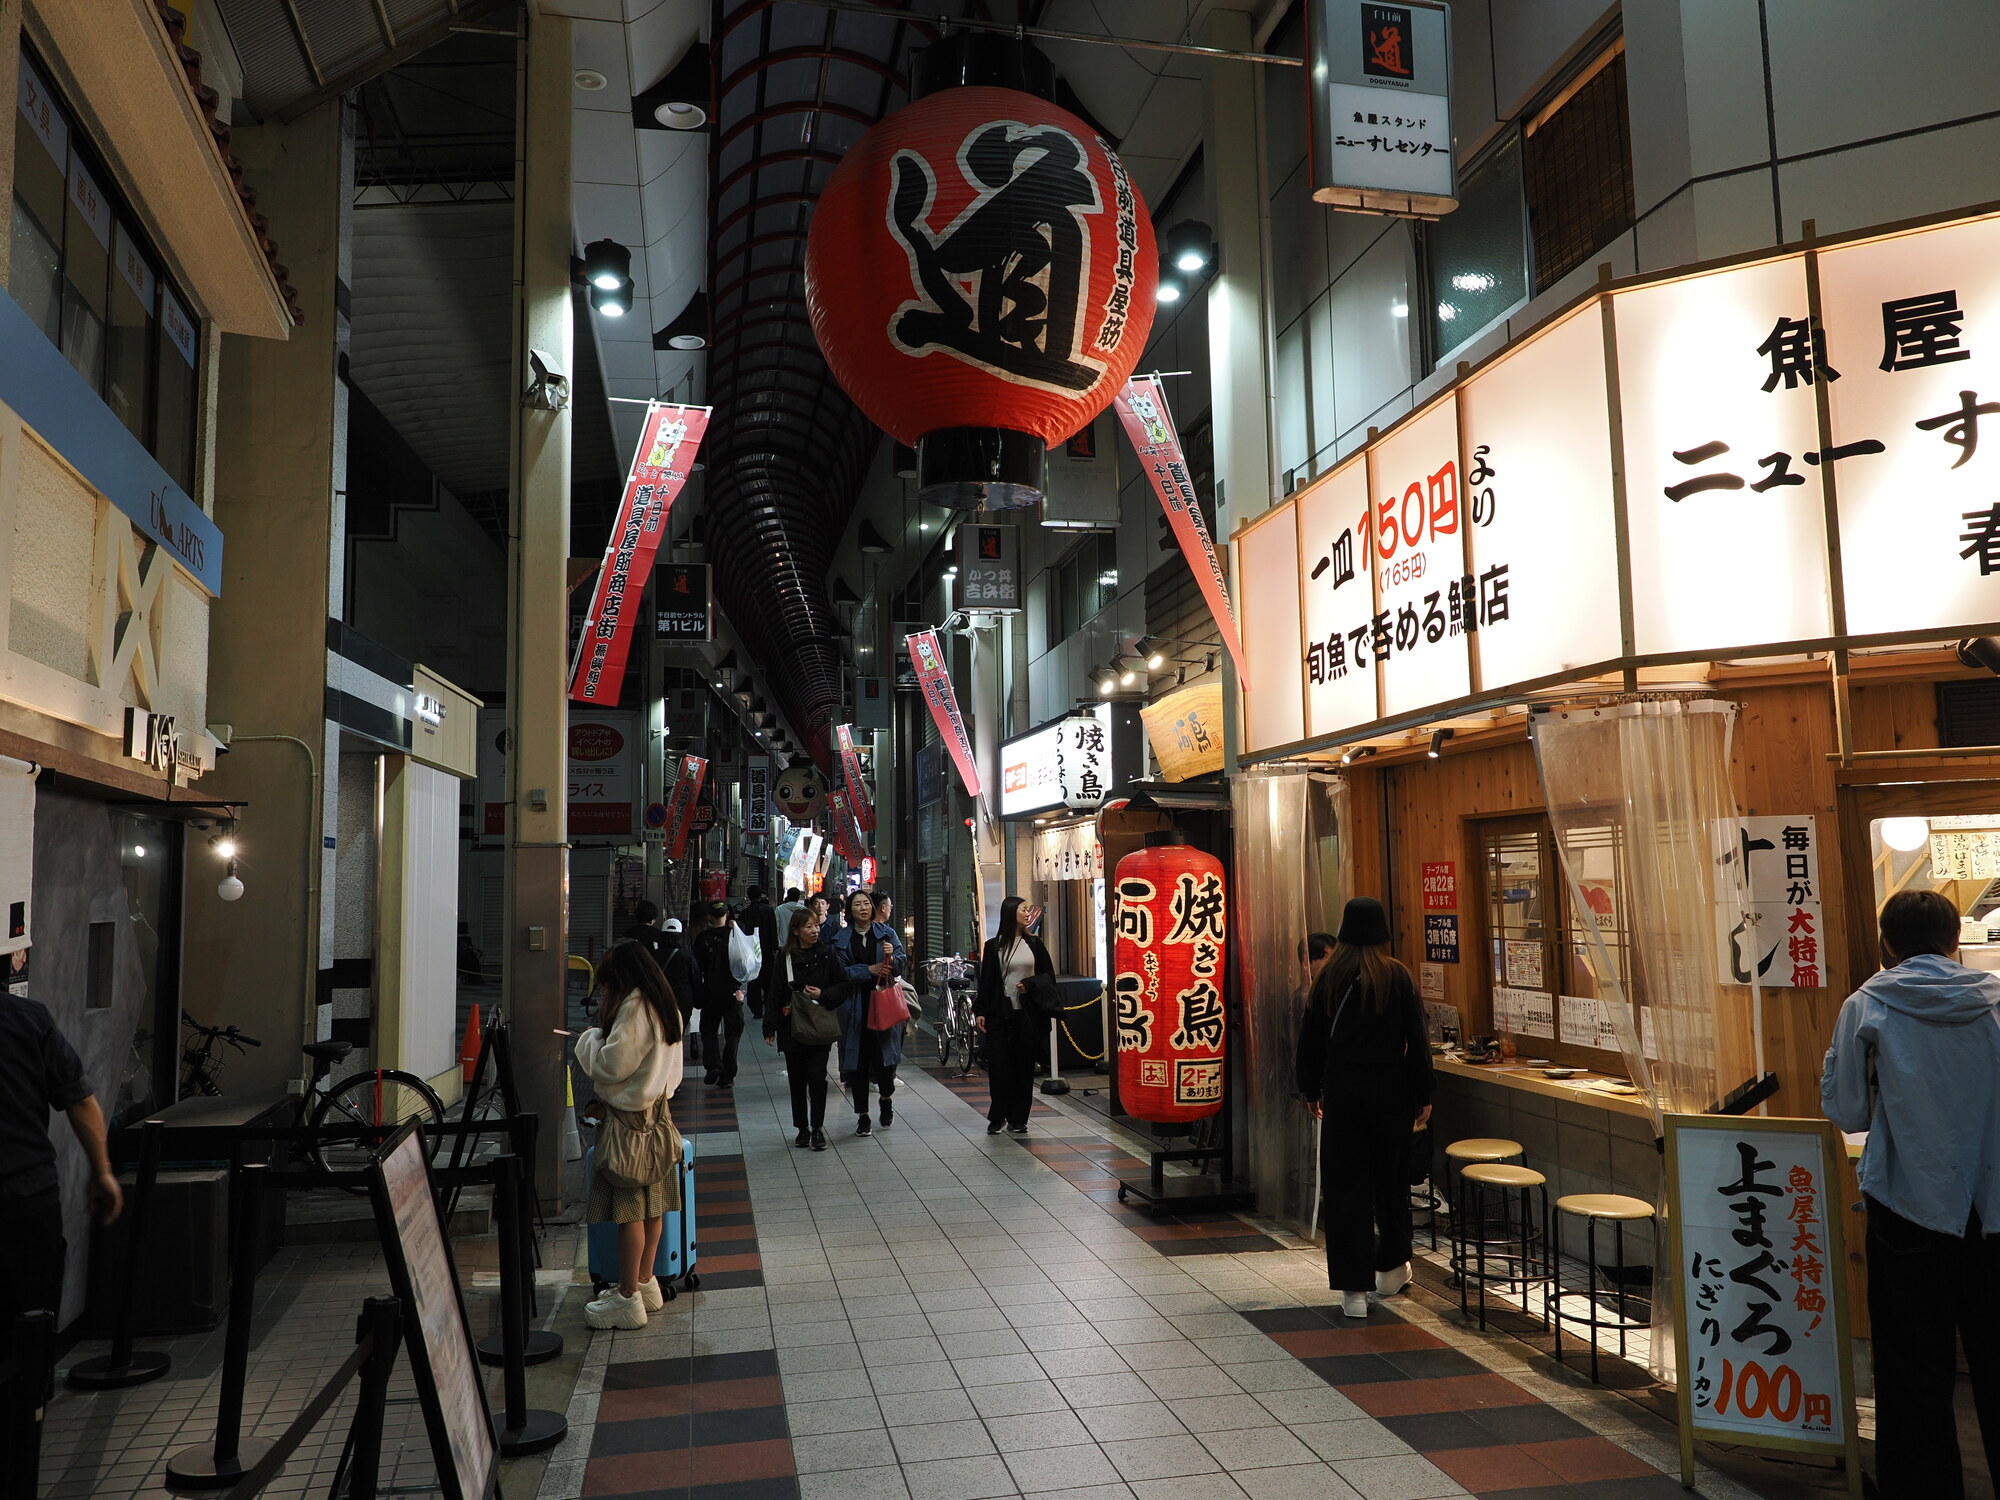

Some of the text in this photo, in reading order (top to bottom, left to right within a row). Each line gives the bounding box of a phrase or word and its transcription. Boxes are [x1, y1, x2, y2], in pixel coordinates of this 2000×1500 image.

[1369, 78, 1410, 88] DOGUYASUJI
[1353, 111, 1427, 130] 魚屋スタンド
[1335, 134, 1450, 157] ニューすしセンター
[1756, 289, 1971, 394] 魚屋
[1664, 389, 2000, 503] ニューす
[1468, 445, 1496, 528] より
[643, 484, 670, 533] 千日前
[176, 522, 204, 572] ARTS
[595, 484, 654, 640] 道具屋筋商店街
[968, 569, 1013, 583] かつ丼
[657, 611, 705, 619] 千日前セントラル
[657, 620, 705, 632] 第1ビル
[574, 729, 612, 737] アウトドアや
[577, 738, 612, 746] イベントの
[568, 767, 615, 775] メ食材が揃う店
[1075, 724, 1105, 800] 焼き鳥
[751, 769, 767, 830] 道具屋筋
[1424, 875, 1454, 892] 2階22席
[1426, 865, 1449, 875] テーブル席
[1427, 929, 1457, 946] 3階16席
[1142, 951, 1161, 1002] あちょう
[1164, 873, 1224, 1052] 焼き鳥
[1182, 1067, 1207, 1087] 2F
[1717, 1141, 1792, 1356] 上まぐろ
[1692, 1251, 1725, 1347] にぎり
[1714, 1358, 1832, 1427] 100円
